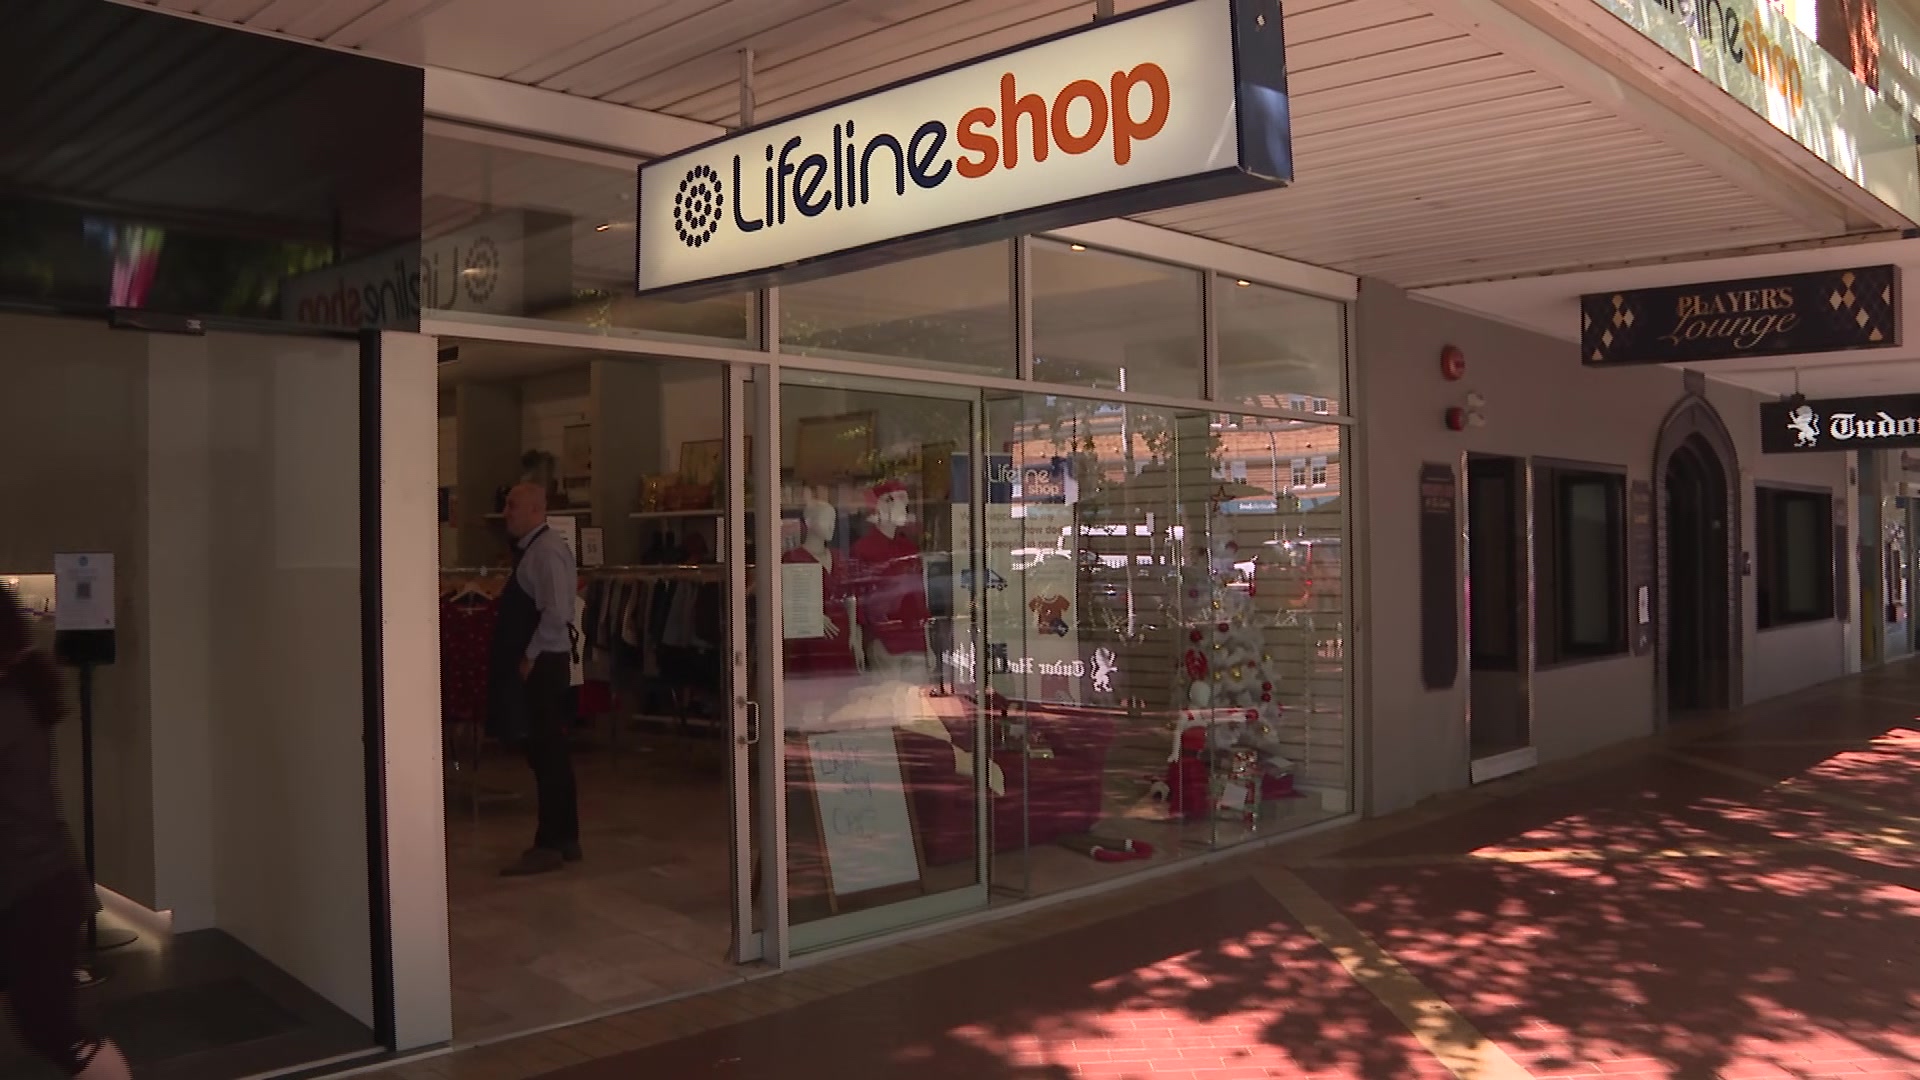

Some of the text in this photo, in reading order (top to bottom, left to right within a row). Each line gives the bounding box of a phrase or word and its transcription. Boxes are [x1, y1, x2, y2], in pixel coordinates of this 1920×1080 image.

[1677, 287, 1794, 316] PLAYERS
[1657, 300, 1798, 349] Lounge
[1829, 411, 1920, 440] Tudo
[988, 463, 1050, 483] Lifelne
[1028, 482, 1060, 496] shop
